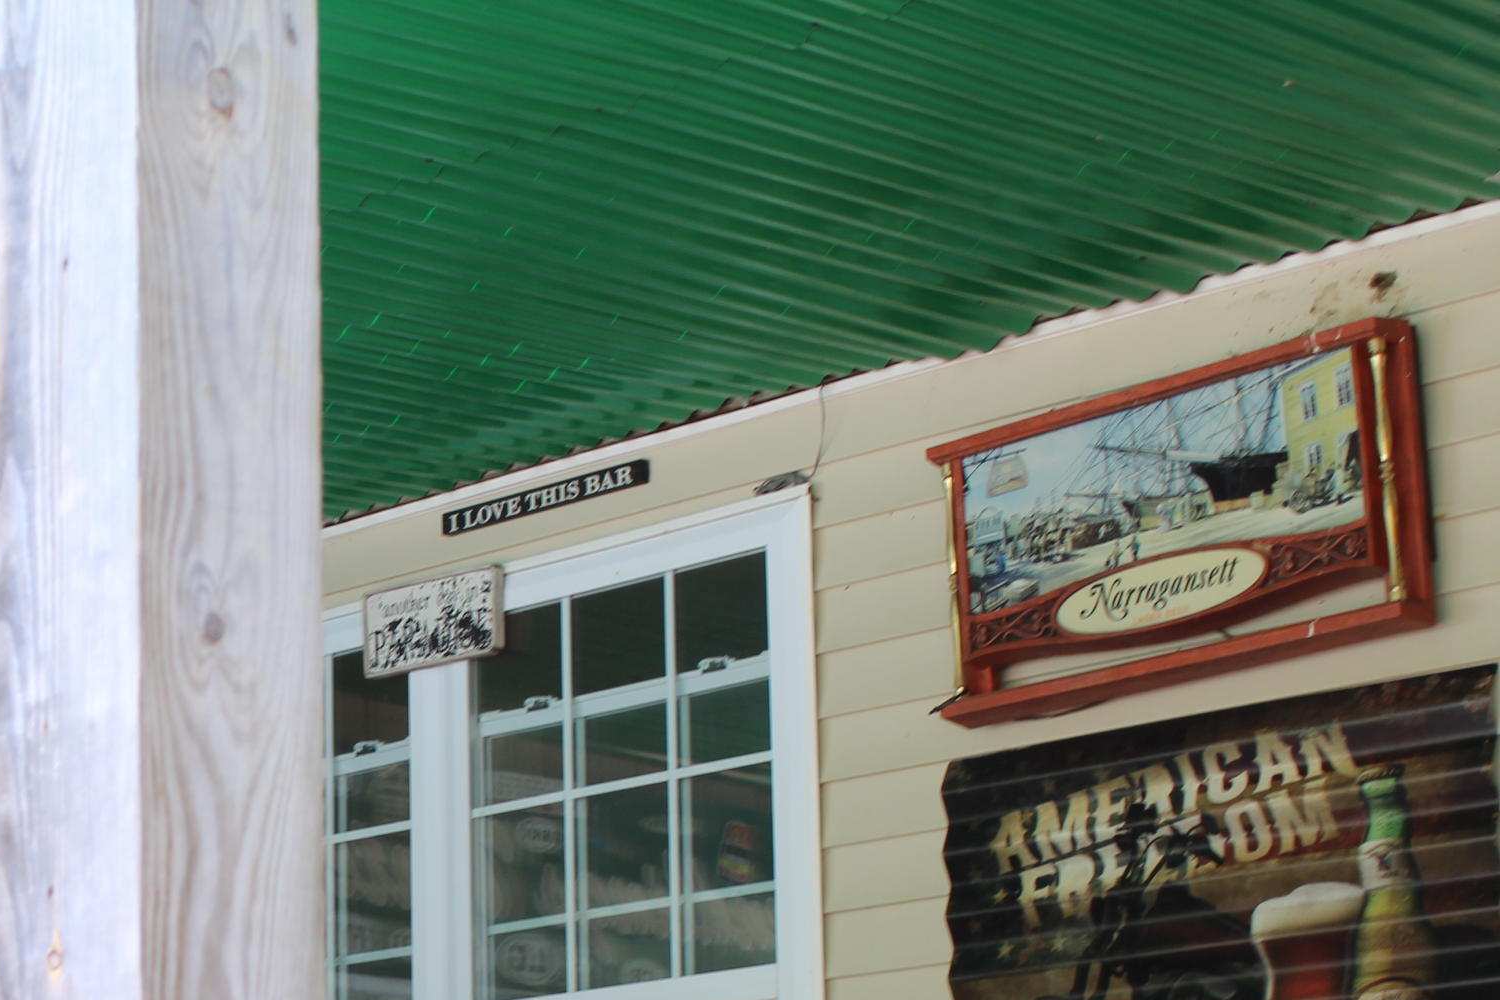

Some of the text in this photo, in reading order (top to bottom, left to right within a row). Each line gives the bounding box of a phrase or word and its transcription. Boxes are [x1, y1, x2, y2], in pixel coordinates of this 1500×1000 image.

[449, 465, 635, 534] I LOVE THIS BAR
[1079, 556, 1240, 622] Narragansett
[988, 722, 1361, 873] AMERICAN
